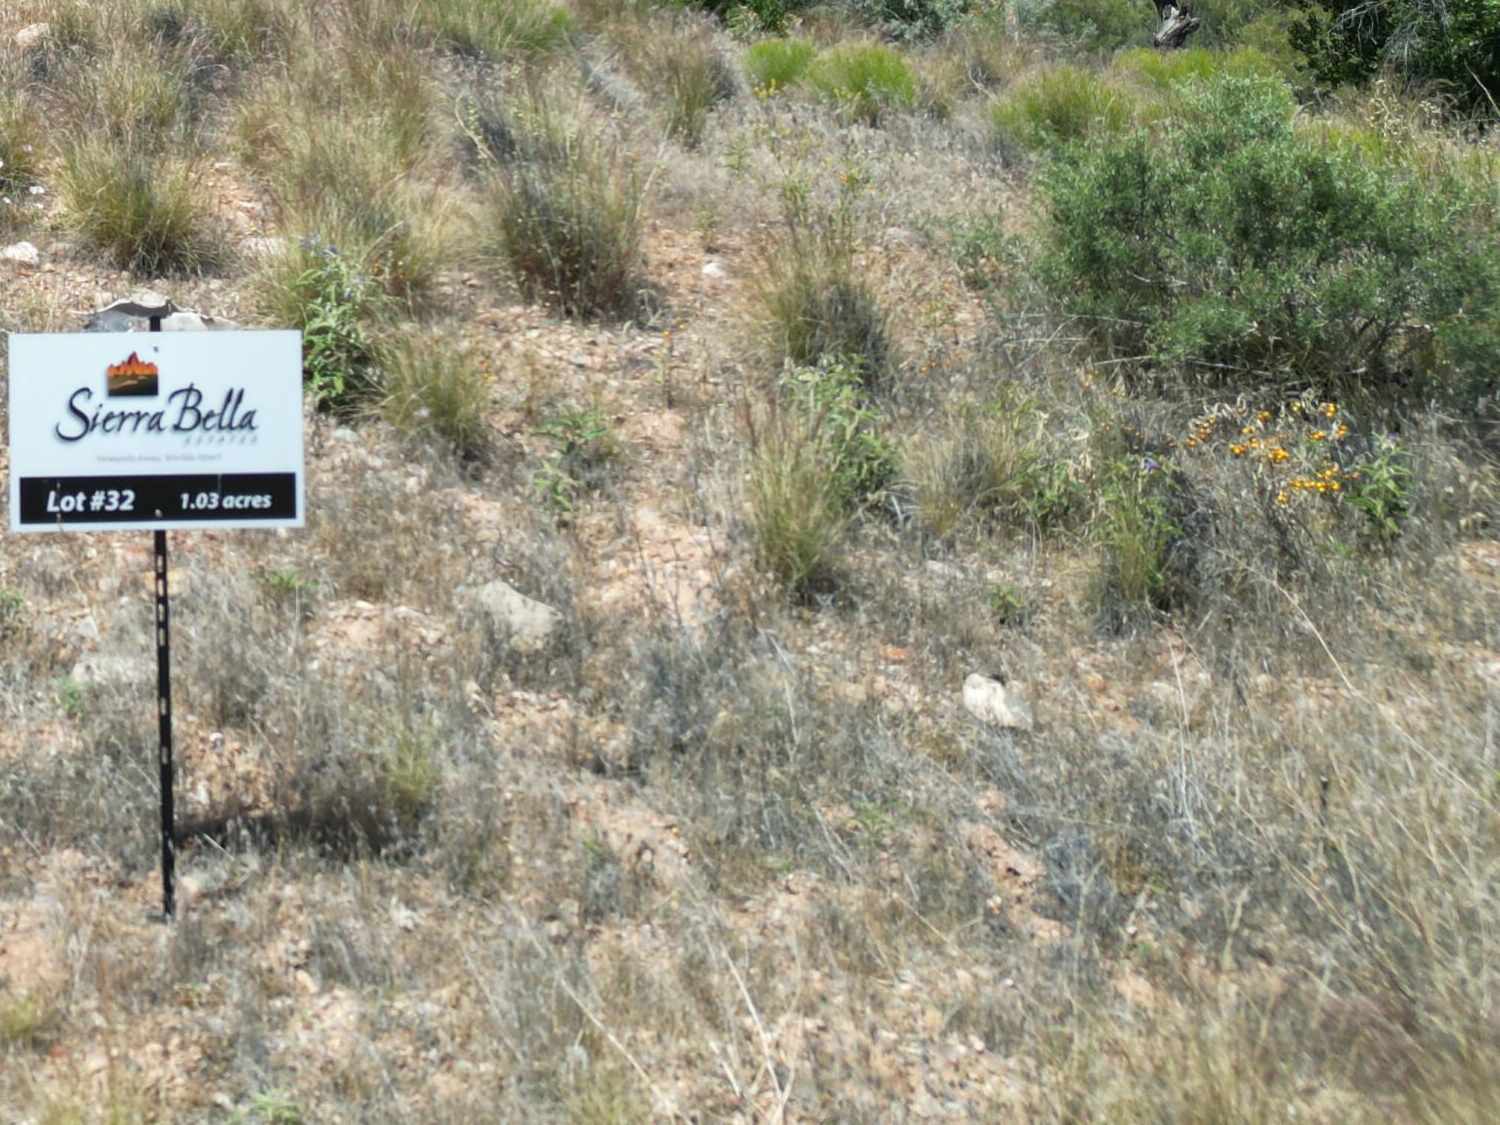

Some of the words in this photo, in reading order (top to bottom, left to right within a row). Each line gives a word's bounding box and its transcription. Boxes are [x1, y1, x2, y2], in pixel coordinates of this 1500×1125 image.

[55, 387, 167, 442] Sierra
[168, 382, 258, 432] Bella
[46, 491, 85, 512] Lot
[90, 490, 135, 511] #32
[181, 492, 219, 511] 1.03
[222, 493, 272, 510] acres
